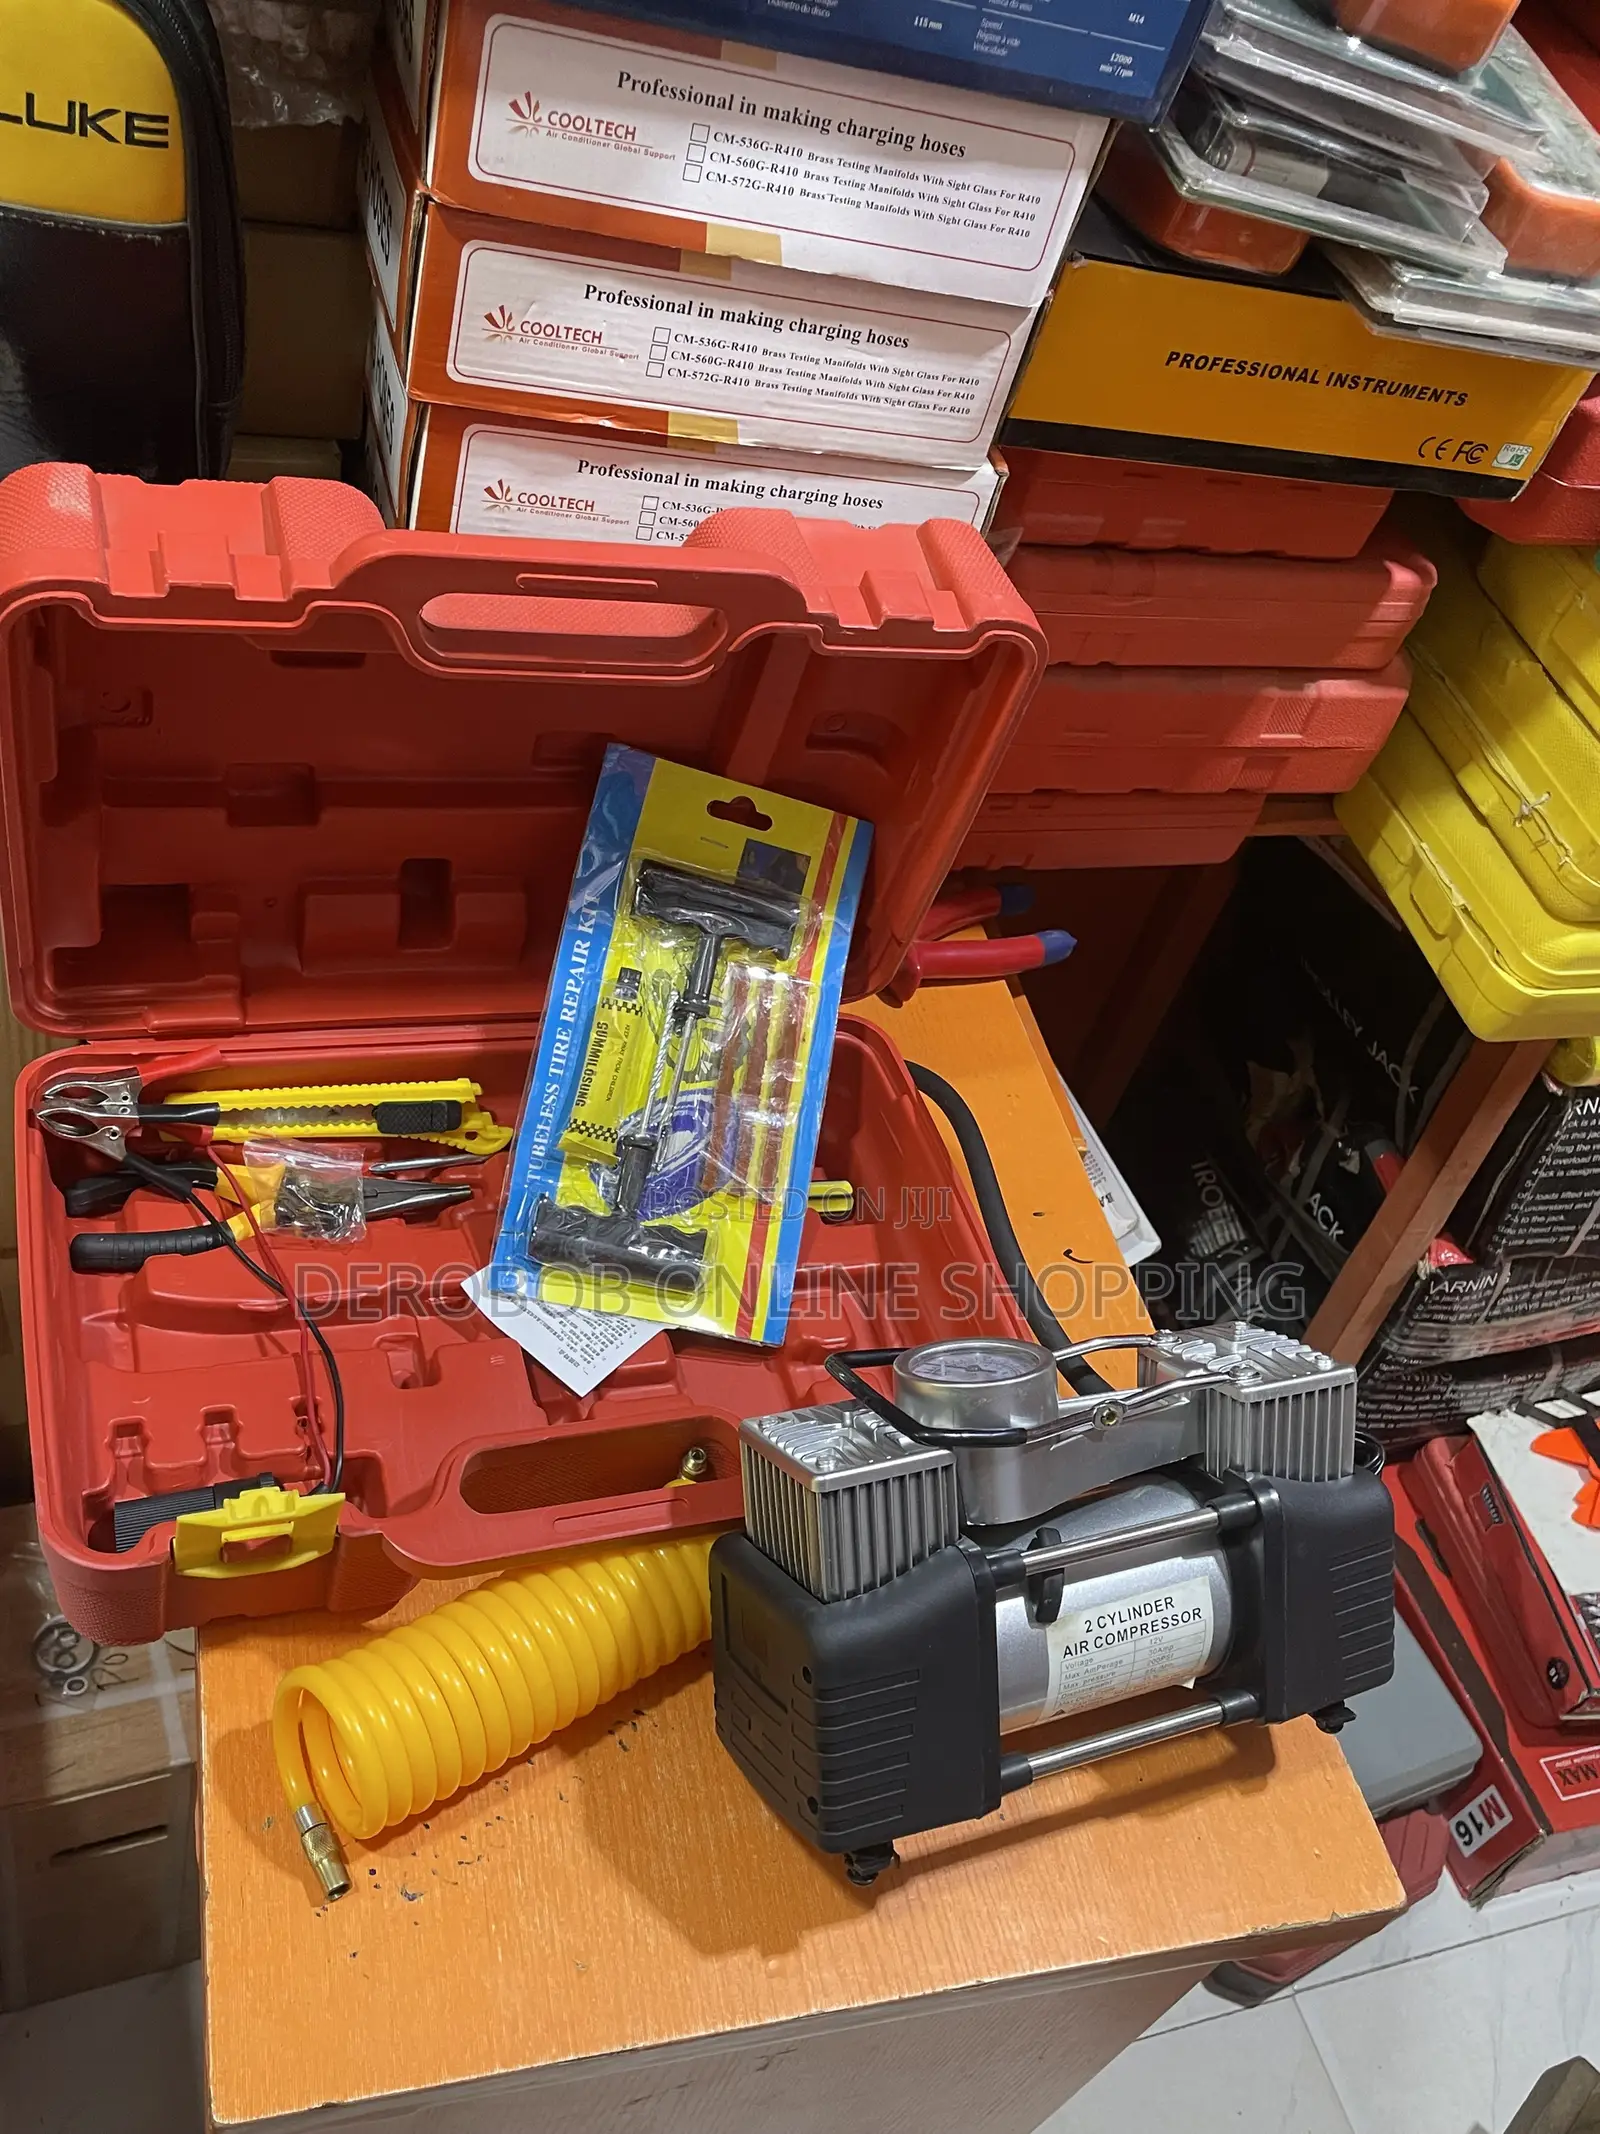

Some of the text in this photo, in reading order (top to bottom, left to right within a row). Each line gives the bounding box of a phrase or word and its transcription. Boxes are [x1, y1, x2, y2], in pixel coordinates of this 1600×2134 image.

[1128, 13, 1145, 24] M14
[1110, 52, 1133, 65] 12000
[547, 110, 637, 142] COOLTECH
[616, 70, 966, 158] Professional in making charging hoses
[546, 129, 676, 161] Air Conditioner Global Support
[713, 131, 1041, 204] CM-536G-R410 Brass Testing Manifolds With Sight Glass For R410
[705, 171, 1030, 237] CM-572G-R410 Brass Testing Manifolds With Sight Glass For R410
[709, 151, 1035, 221] CM-560G-R410 Brass Testing Manifolds With Sight Glass For R410
[520, 321, 603, 345] COOLTECH
[583, 283, 909, 348] Professional in making charging hoses
[519, 336, 640, 361] Air Conditioner Global Support
[674, 333, 979, 386] CM-536G-R410 Brass Testing Manifolds With Sight Glass For R410
[667, 367, 970, 414] CM-572G-R410 Brass Testing Manifolds With Sight Glass For R410
[670, 350, 975, 400] CM-560G-R410 Brass Testing Manifolds With Sight Glass For R410
[1165, 351, 1469, 407] PROFESSIONAL INSTRUMENTS
[517, 492, 595, 512] COOLTECH
[576, 453, 883, 509] Professional in making charging hoses
[529, 507, 573, 519] Conditioner
[575, 513, 599, 522] Global
[601, 516, 630, 526] Support
[527, 891, 600, 1182] TUBELESS TIRE REPAIR KIT
[1063, 1607, 1202, 1659] AIR COMPRESSOR
[1084, 1596, 1175, 1633] 2 CYLINDER
[1064, 1672, 1080, 1680] Max
[1455, 1794, 1506, 1847] M16
